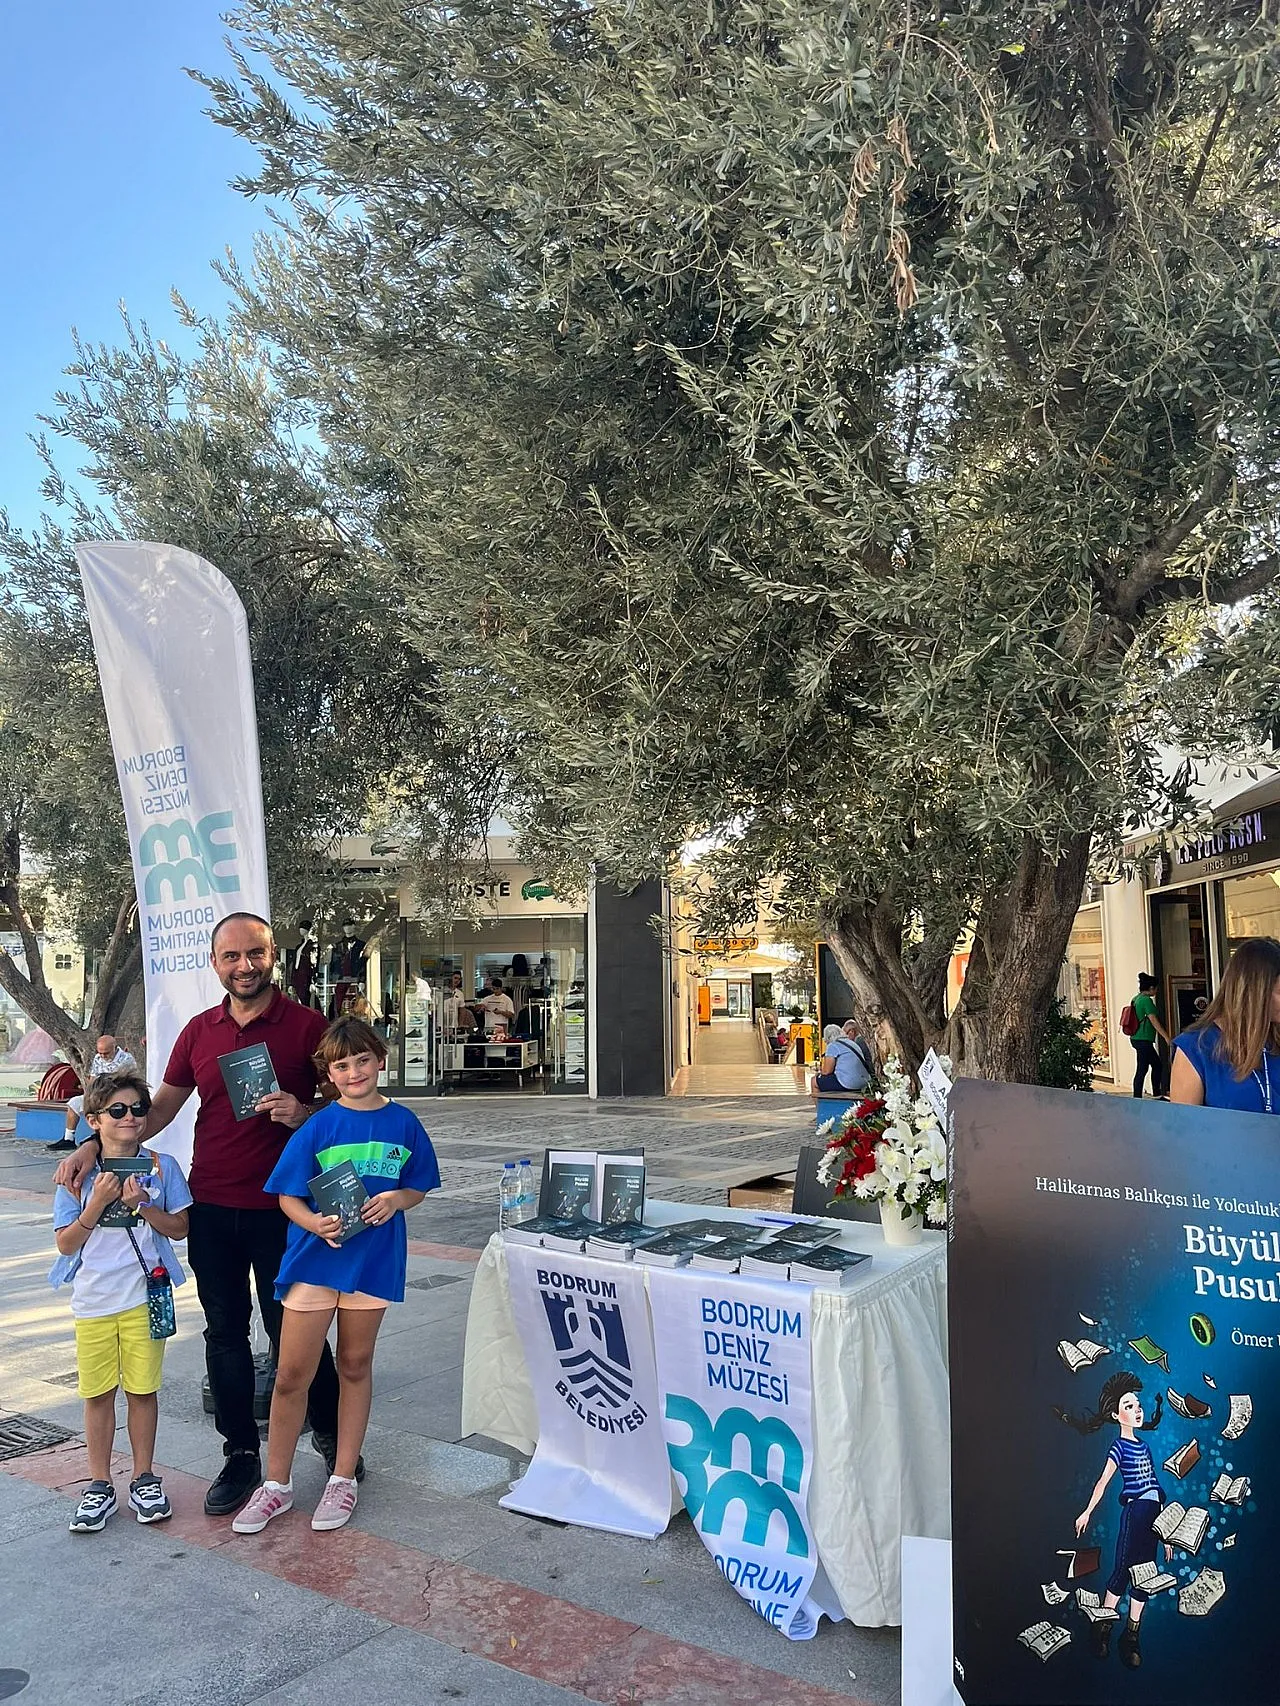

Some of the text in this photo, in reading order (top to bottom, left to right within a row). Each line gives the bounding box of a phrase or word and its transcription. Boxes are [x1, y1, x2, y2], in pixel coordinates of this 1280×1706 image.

[1035, 1176, 1280, 1218] Halikarnas Balıkçısı ile Yolculuk
[537, 1269, 617, 1299] BODRUM
[701, 1297, 801, 1339] BODRUM
[1231, 1327, 1274, 1348] Ömer
[704, 1330, 772, 1367] DENİZ
[706, 1361, 789, 1405] MÜZESİ
[555, 1379, 648, 1434] BELEDİYESİ
[714, 1554, 803, 1599] ODRUM
